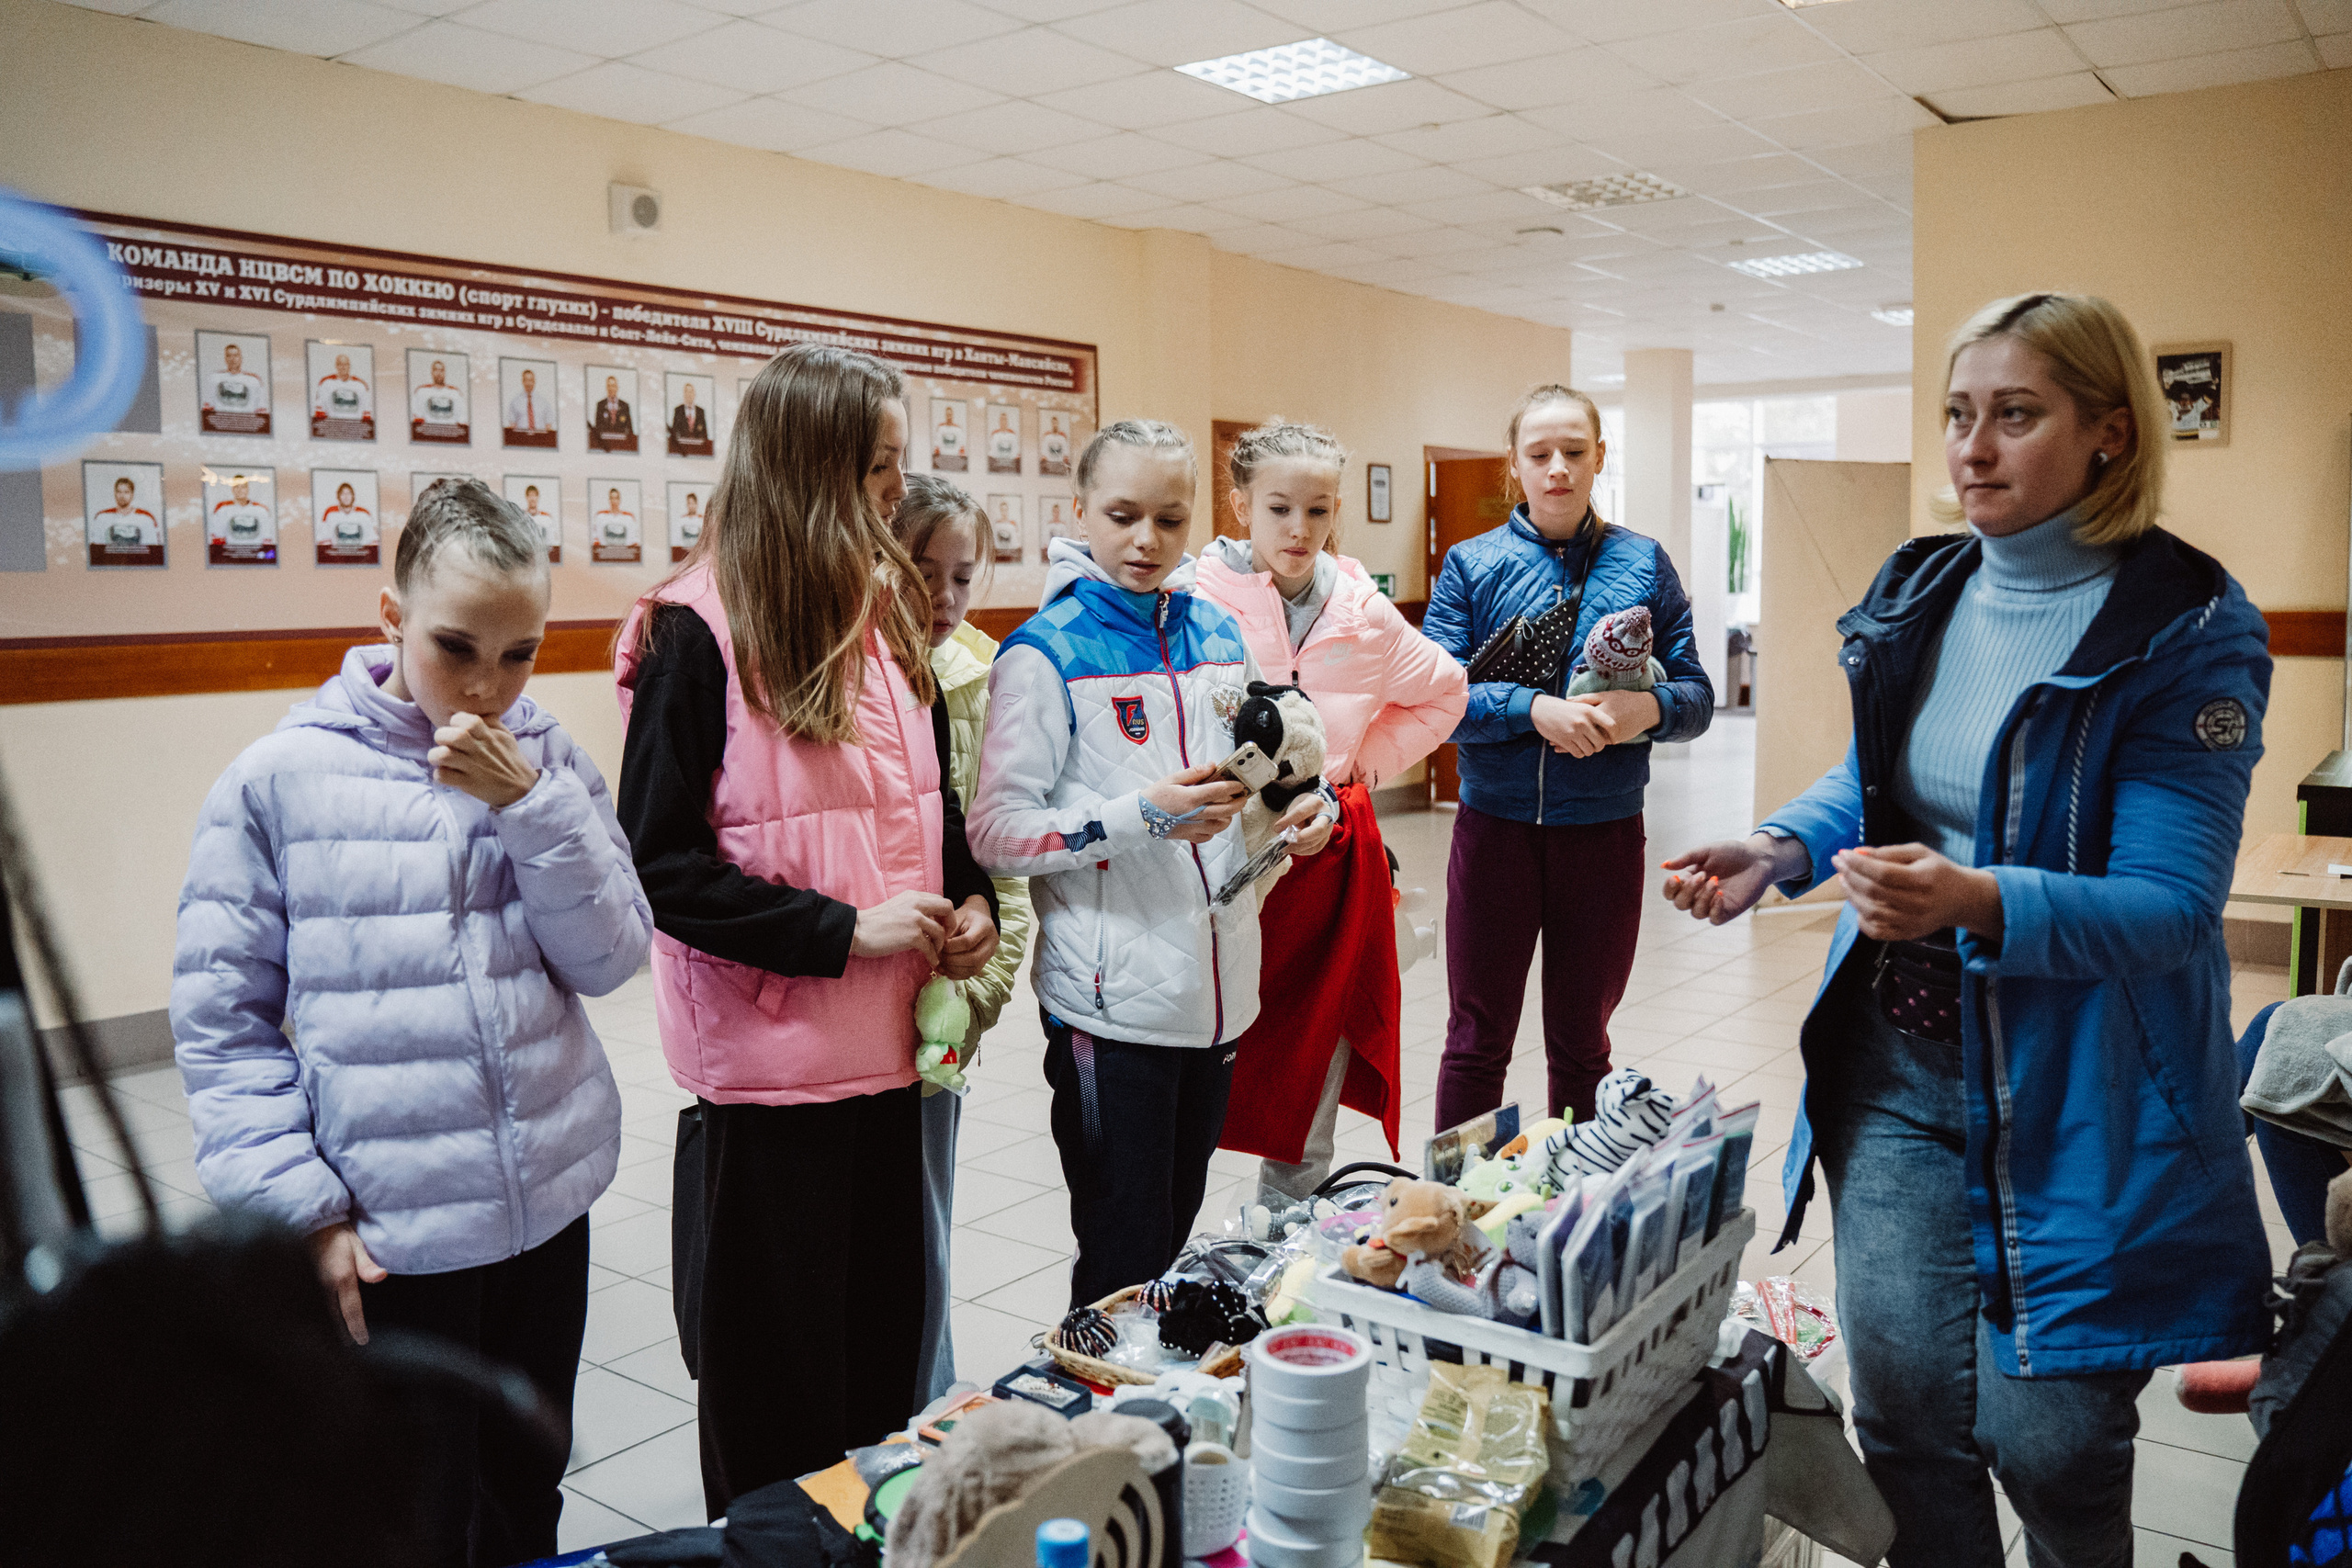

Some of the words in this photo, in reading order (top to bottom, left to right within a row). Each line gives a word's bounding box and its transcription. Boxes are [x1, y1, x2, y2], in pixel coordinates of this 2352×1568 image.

[107, 242, 235, 277] КОМАНДА
[239, 257, 324, 286] НЦВСМ
[327, 268, 360, 290] ПО
[363, 273, 456, 301] ХОККЕЮ
[458, 285, 525, 311] (спорт
[526, 295, 598, 321] глухих)
[612, 304, 711, 331] победители
[712, 315, 754, 336] XVIII
[195, 280, 220, 296] XV
[223, 286, 236, 299] и
[238, 285, 272, 302] XVI
[477, 313, 504, 330] игр
